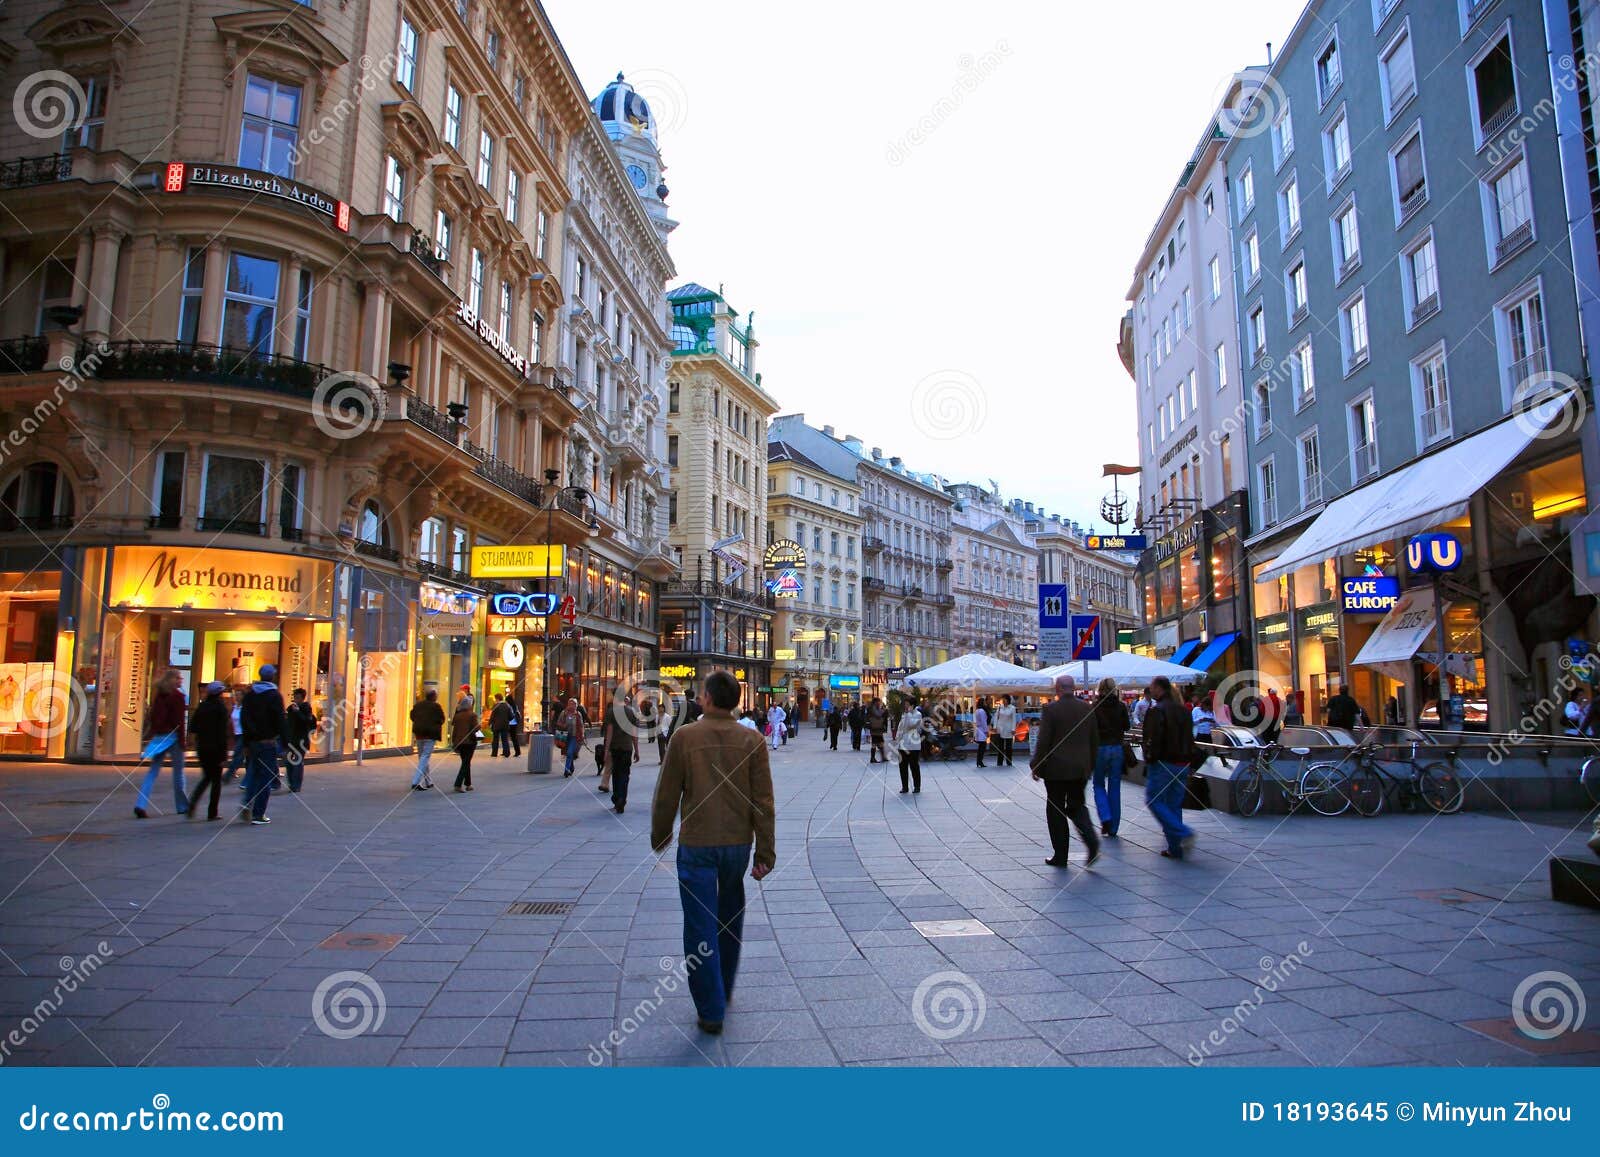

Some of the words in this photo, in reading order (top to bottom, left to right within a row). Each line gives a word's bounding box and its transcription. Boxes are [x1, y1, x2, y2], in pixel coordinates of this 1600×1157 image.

[192, 168, 281, 193] Elizabeth
[290, 186, 334, 212] Arden
[771, 555, 798, 563] BUFFET
[1408, 542, 1422, 569] U
[1431, 540, 1457, 567] U
[135, 551, 302, 596] Marionnaud
[1344, 581, 1377, 594] CAFE
[491, 617, 546, 633] ZEISS
